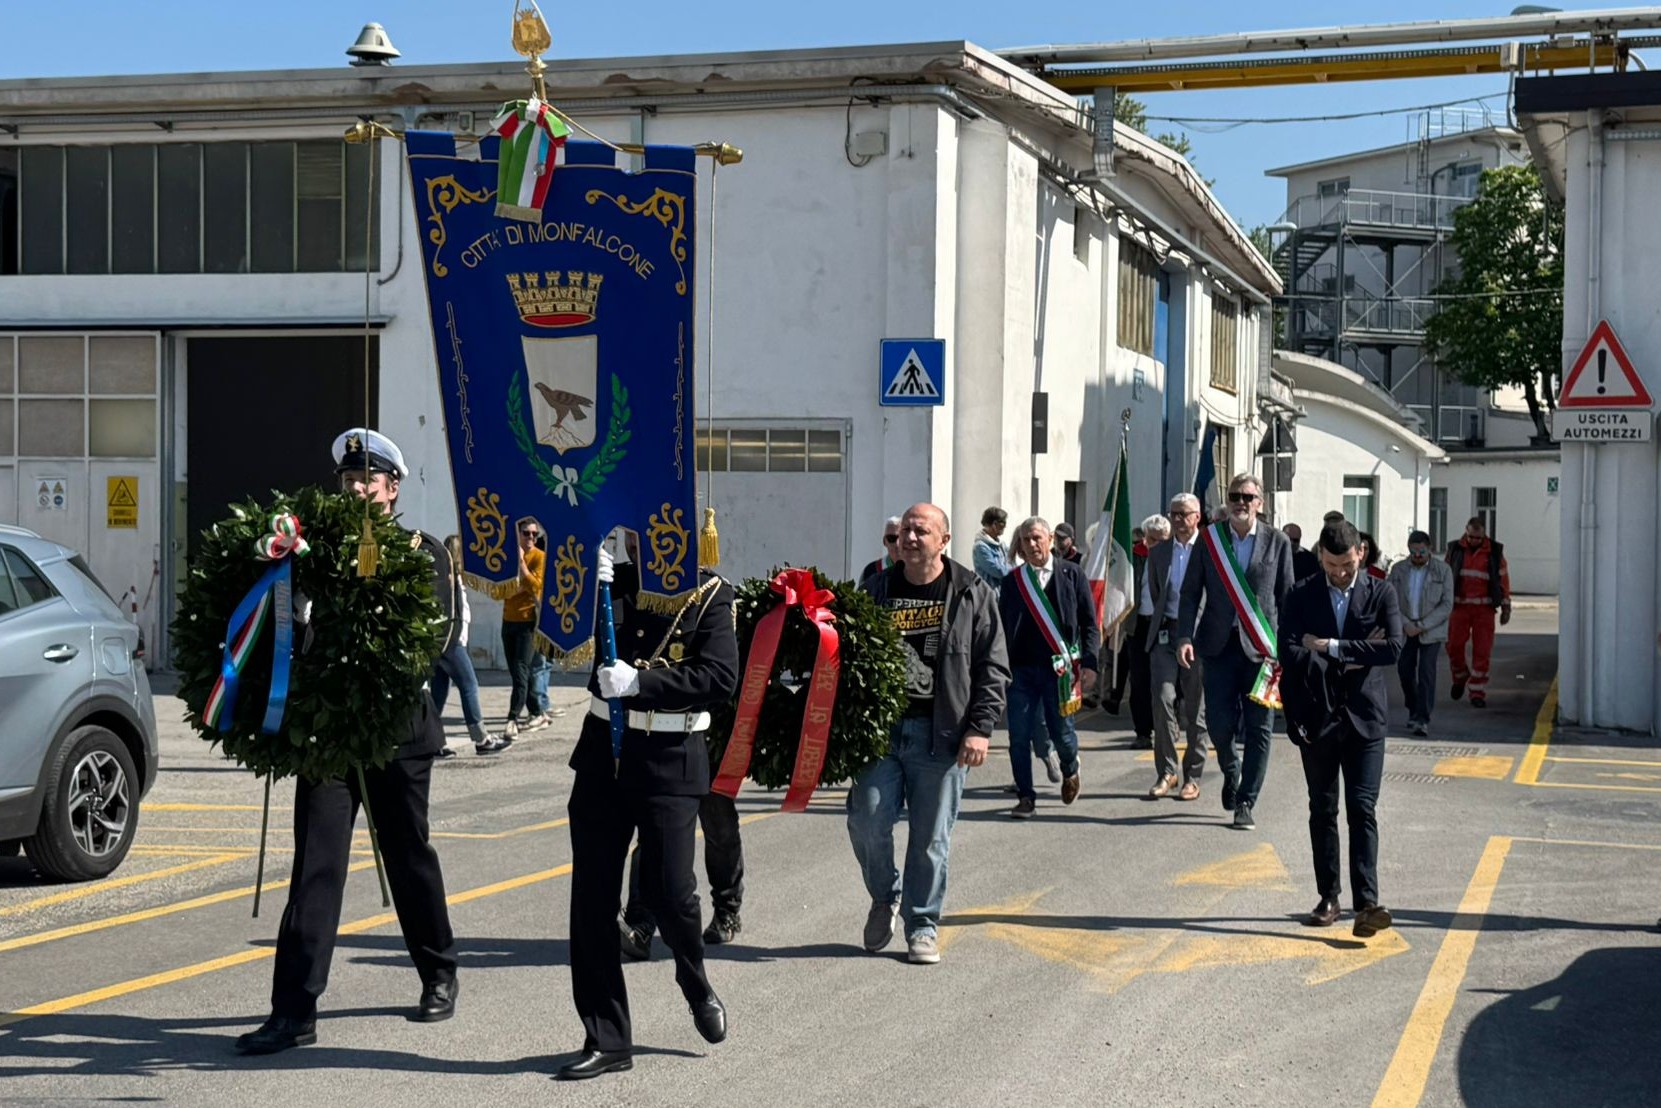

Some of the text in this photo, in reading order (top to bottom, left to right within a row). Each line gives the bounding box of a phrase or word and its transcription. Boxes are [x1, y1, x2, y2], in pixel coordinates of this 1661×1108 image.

[505, 225, 524, 245] DI
[528, 222, 656, 280] MONFALCONE
[1578, 414, 1628, 424] USCITA
[1564, 428, 1642, 439] AUTOMEZZI
